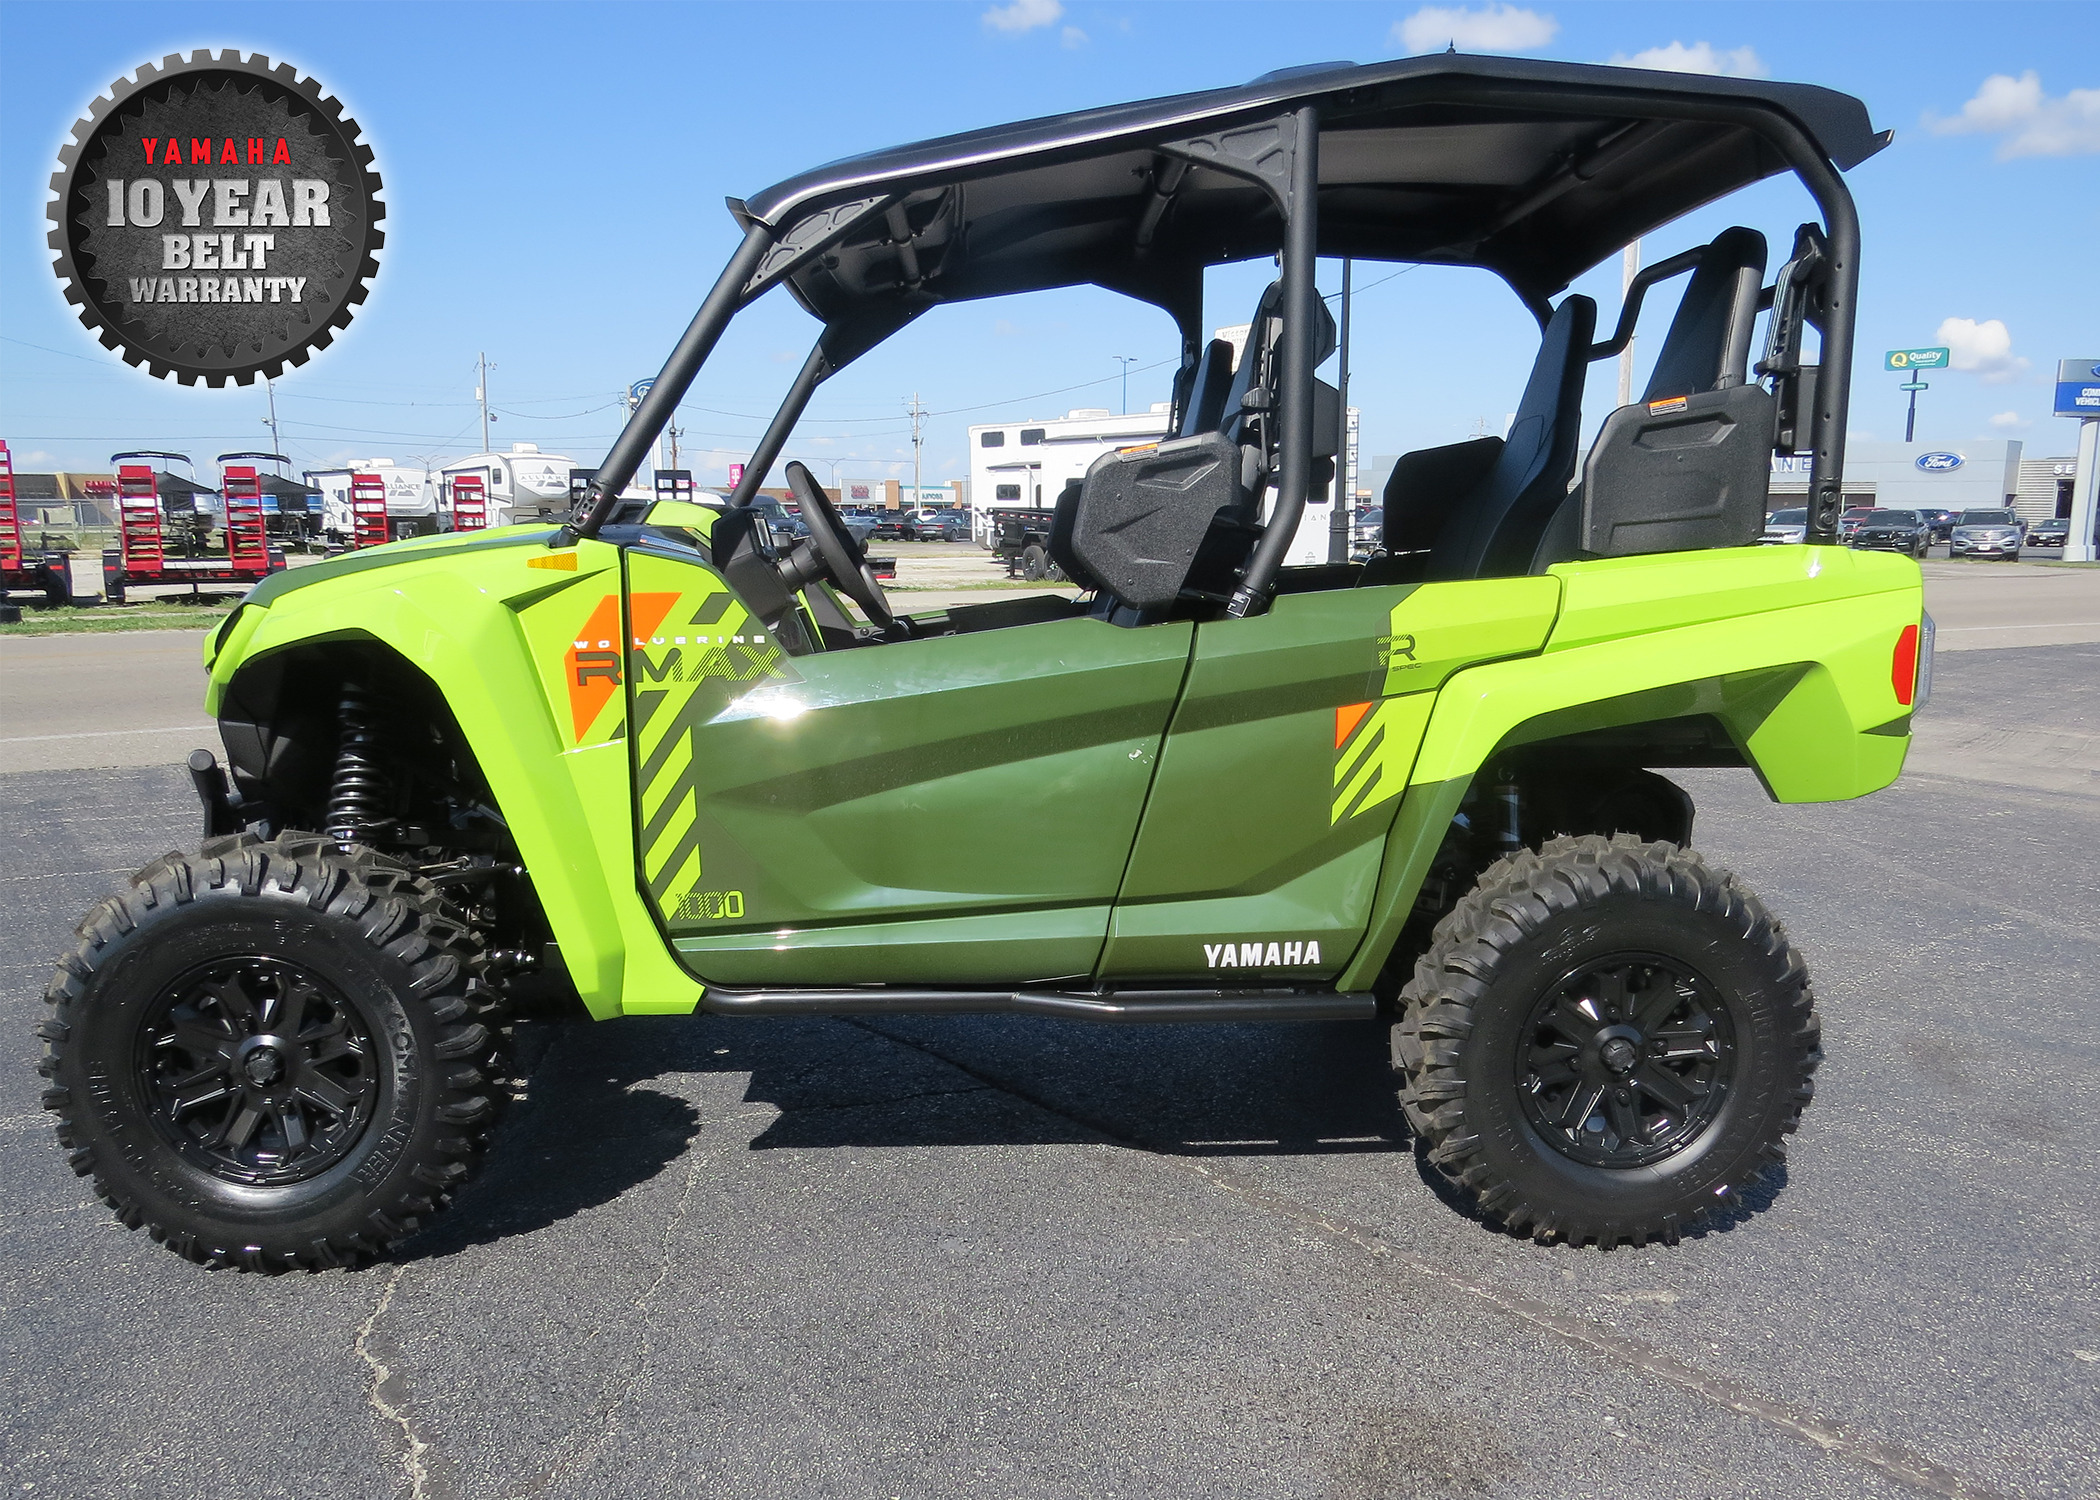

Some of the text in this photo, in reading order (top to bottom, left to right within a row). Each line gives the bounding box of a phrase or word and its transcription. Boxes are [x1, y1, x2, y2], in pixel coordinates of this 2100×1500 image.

[1909, 351, 1942, 361] Quality
[1923, 455, 1954, 469] Ford
[573, 635, 766, 649] WOLVERINE
[1376, 634, 1417, 666] R
[1392, 662, 1422, 672] SPEC
[675, 890, 745, 920] 1000
[1203, 941, 1320, 968] YAMAHA
